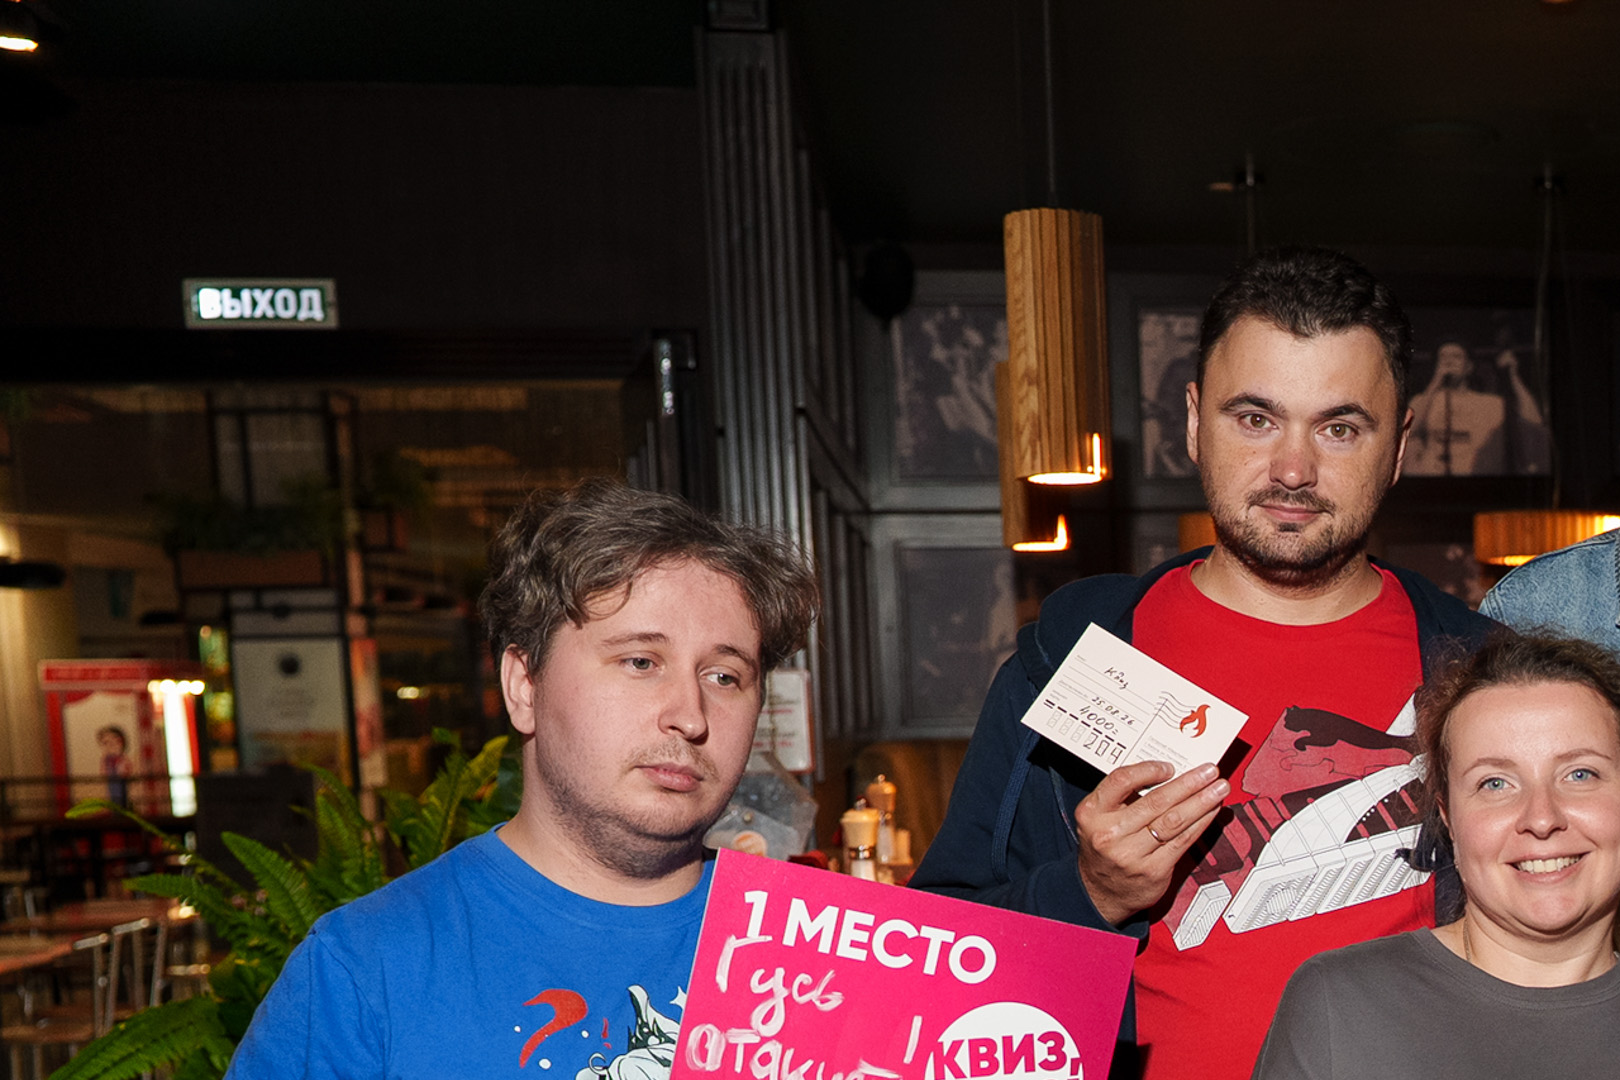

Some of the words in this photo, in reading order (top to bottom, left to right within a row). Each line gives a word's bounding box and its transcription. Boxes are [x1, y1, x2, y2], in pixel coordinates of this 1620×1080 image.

[199, 288, 324, 321] ВЫХОД
[744, 890, 768, 938] 1
[782, 897, 997, 984] МЕСТО
[716, 934, 845, 1037] Гусь
